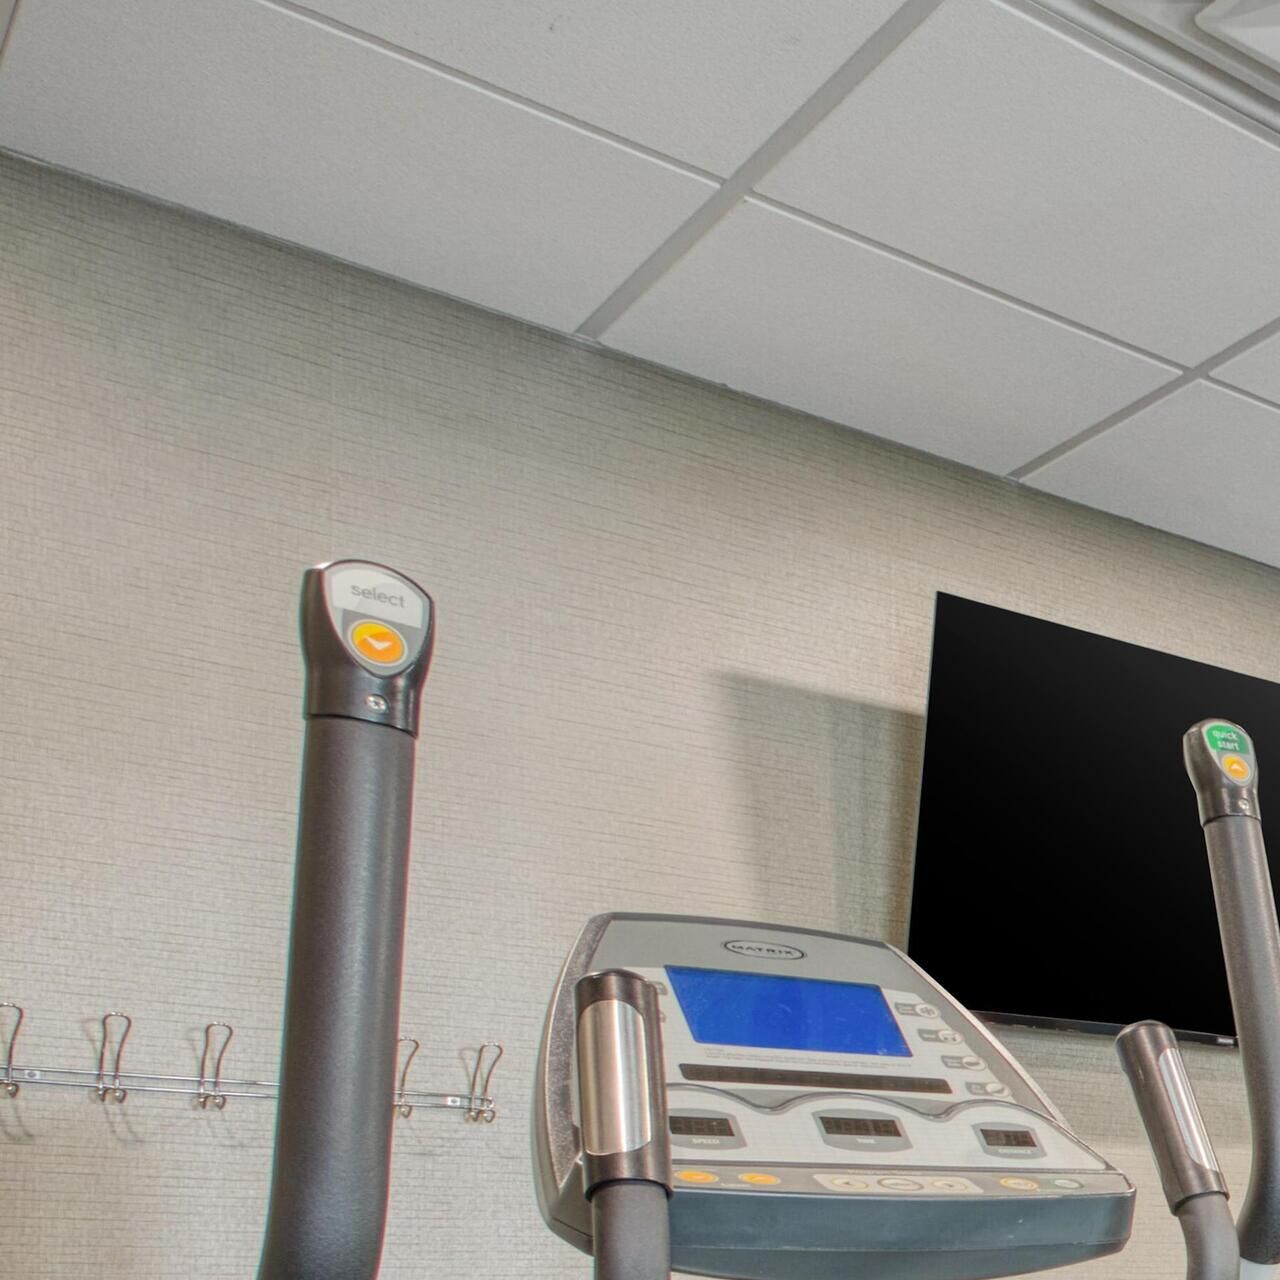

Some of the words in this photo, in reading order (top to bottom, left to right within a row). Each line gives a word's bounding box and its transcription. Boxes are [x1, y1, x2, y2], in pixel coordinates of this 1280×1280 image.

[350, 583, 407, 609] select
[1212, 730, 1238, 741] quick
[1217, 741, 1240, 751] start
[731, 945, 794, 956] MATRIX
